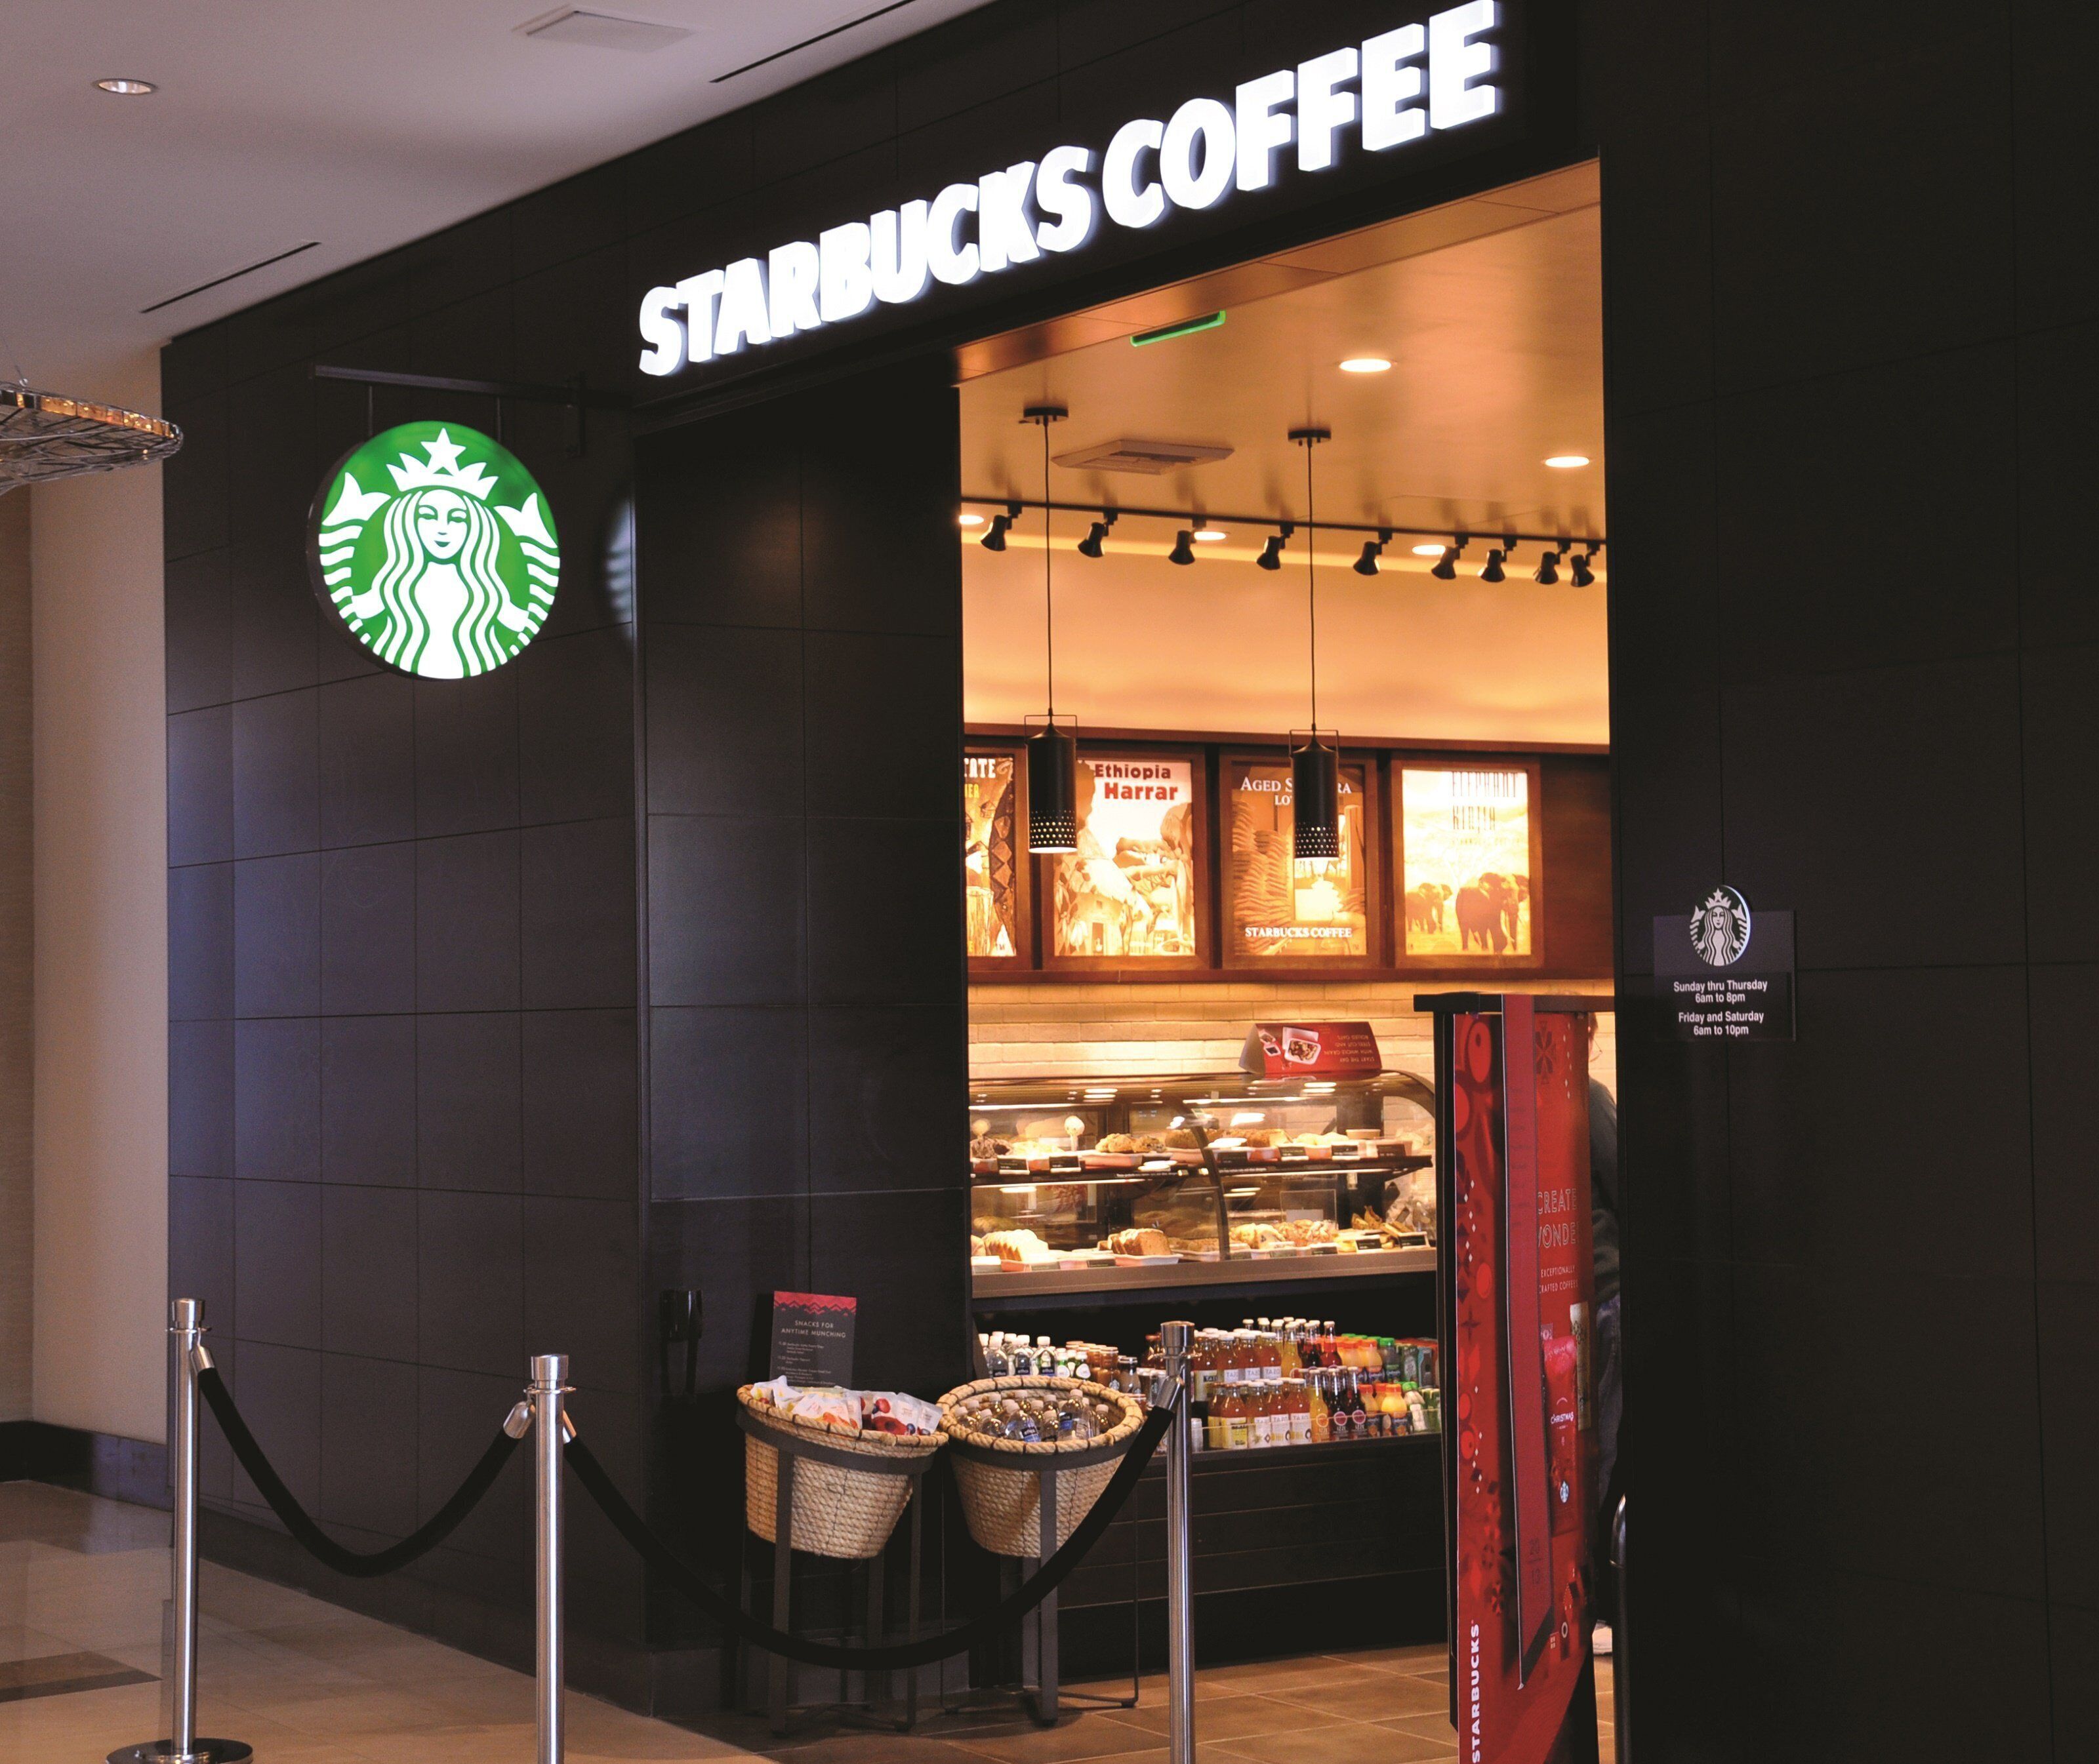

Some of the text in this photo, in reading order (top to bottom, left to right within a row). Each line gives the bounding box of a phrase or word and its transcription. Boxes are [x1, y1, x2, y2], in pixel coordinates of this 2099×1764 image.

[639, 0, 1496, 376] STARBUCKS COFFEE
[1095, 763, 1171, 780] Ethiopia
[1240, 776, 1281, 792] AGED
[1104, 782, 1178, 801] Harrar
[1244, 927, 1353, 938] STARBUCKS COFFEE
[1673, 979, 1768, 993] Sunday thru Thursday
[1695, 992, 1745, 1005] 6am to 8pm
[1678, 1011, 1764, 1024] Friday and Saturday
[1693, 1024, 1749, 1037] 6am to 10pm
[1538, 1188, 1577, 1214] CREATE
[1538, 1222, 1579, 1249] ONDE
[1541, 1264, 1576, 1278] EXCEPTIONALLY
[794, 1319, 819, 1328] SNACKS
[811, 1329, 846, 1338] MUNCHING
[1550, 1411, 1574, 1424] CHRISTMAS
[1471, 1624, 1480, 1764] STARBUCKS
